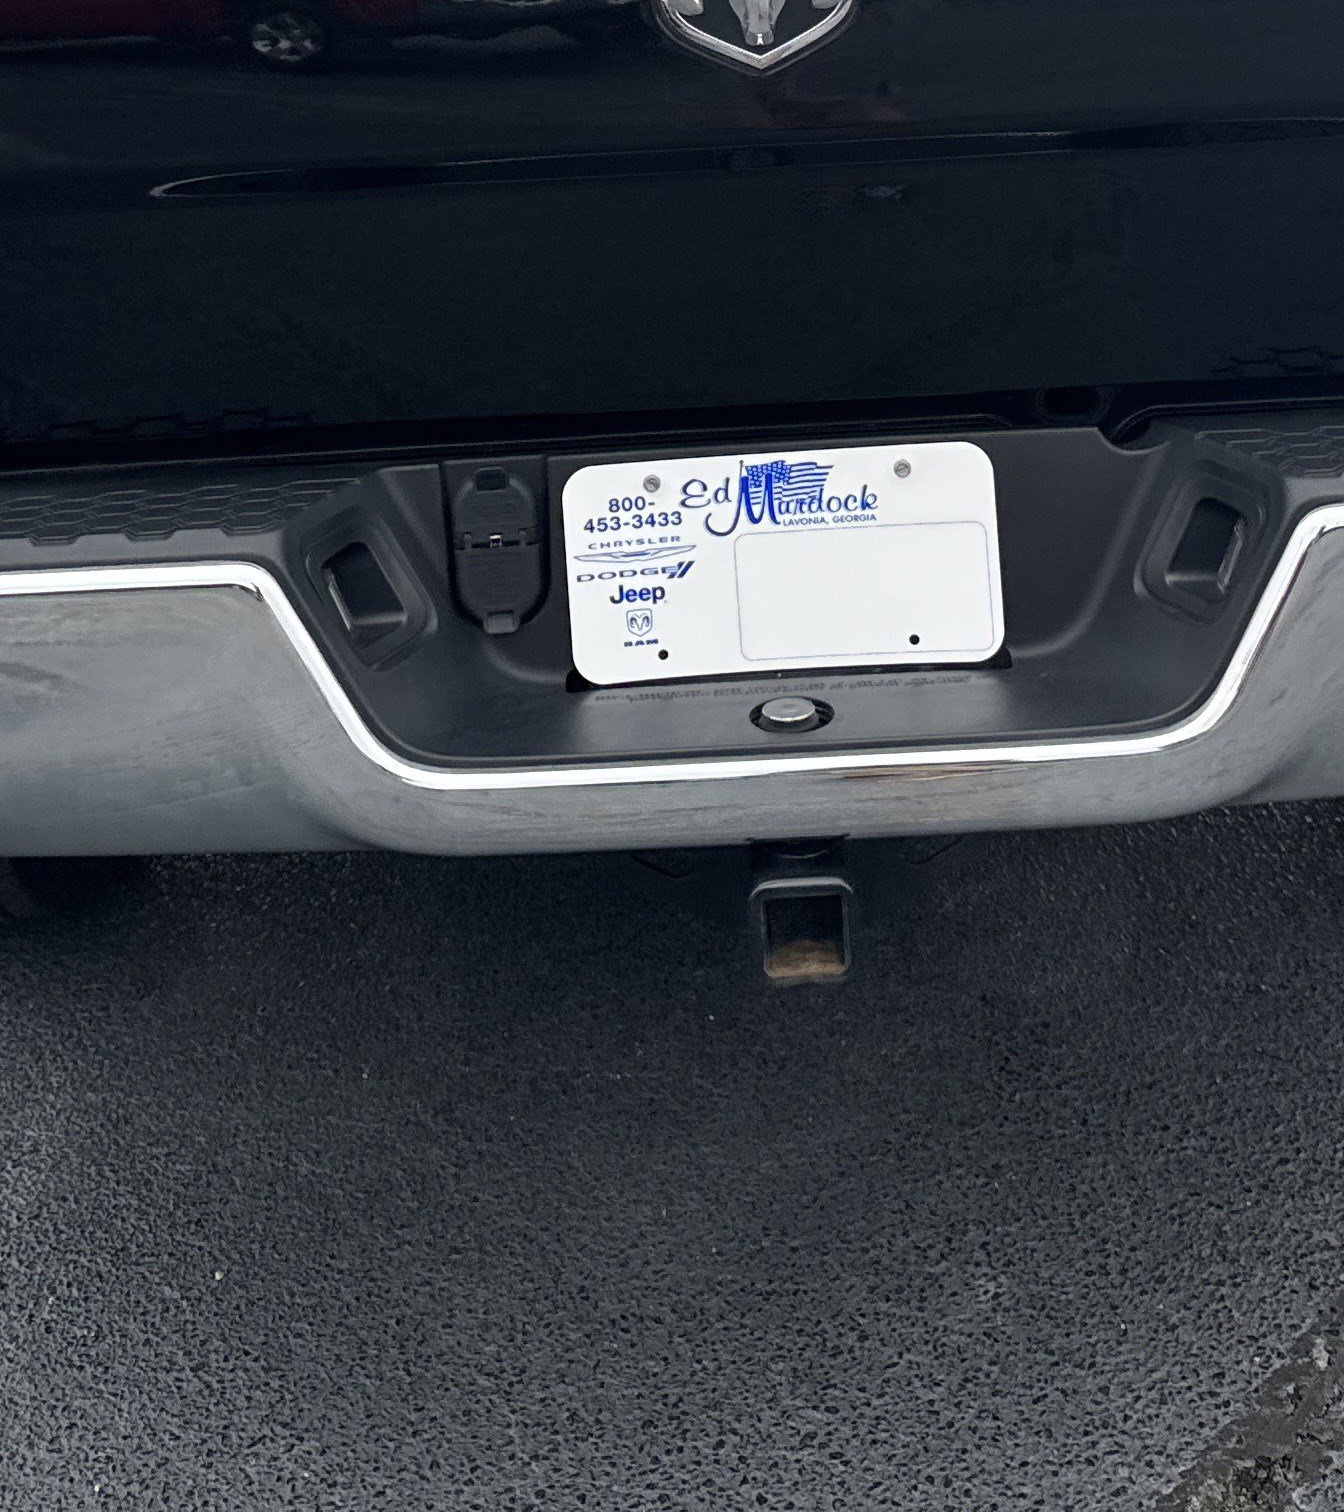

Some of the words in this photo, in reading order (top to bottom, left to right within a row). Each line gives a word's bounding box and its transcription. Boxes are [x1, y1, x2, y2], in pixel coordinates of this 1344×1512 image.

[679, 477, 733, 509] Ed
[608, 496, 655, 513] 800-
[705, 468, 878, 536] Murdock
[584, 511, 683, 533] 453-3433
[783, 515, 829, 526] LAVONIA,
[832, 513, 877, 524] GEORGIA
[588, 536, 681, 549] CHRYSLER
[577, 565, 681, 582] DODGE
[609, 584, 666, 604] Jeep
[624, 639, 659, 647] RAM
